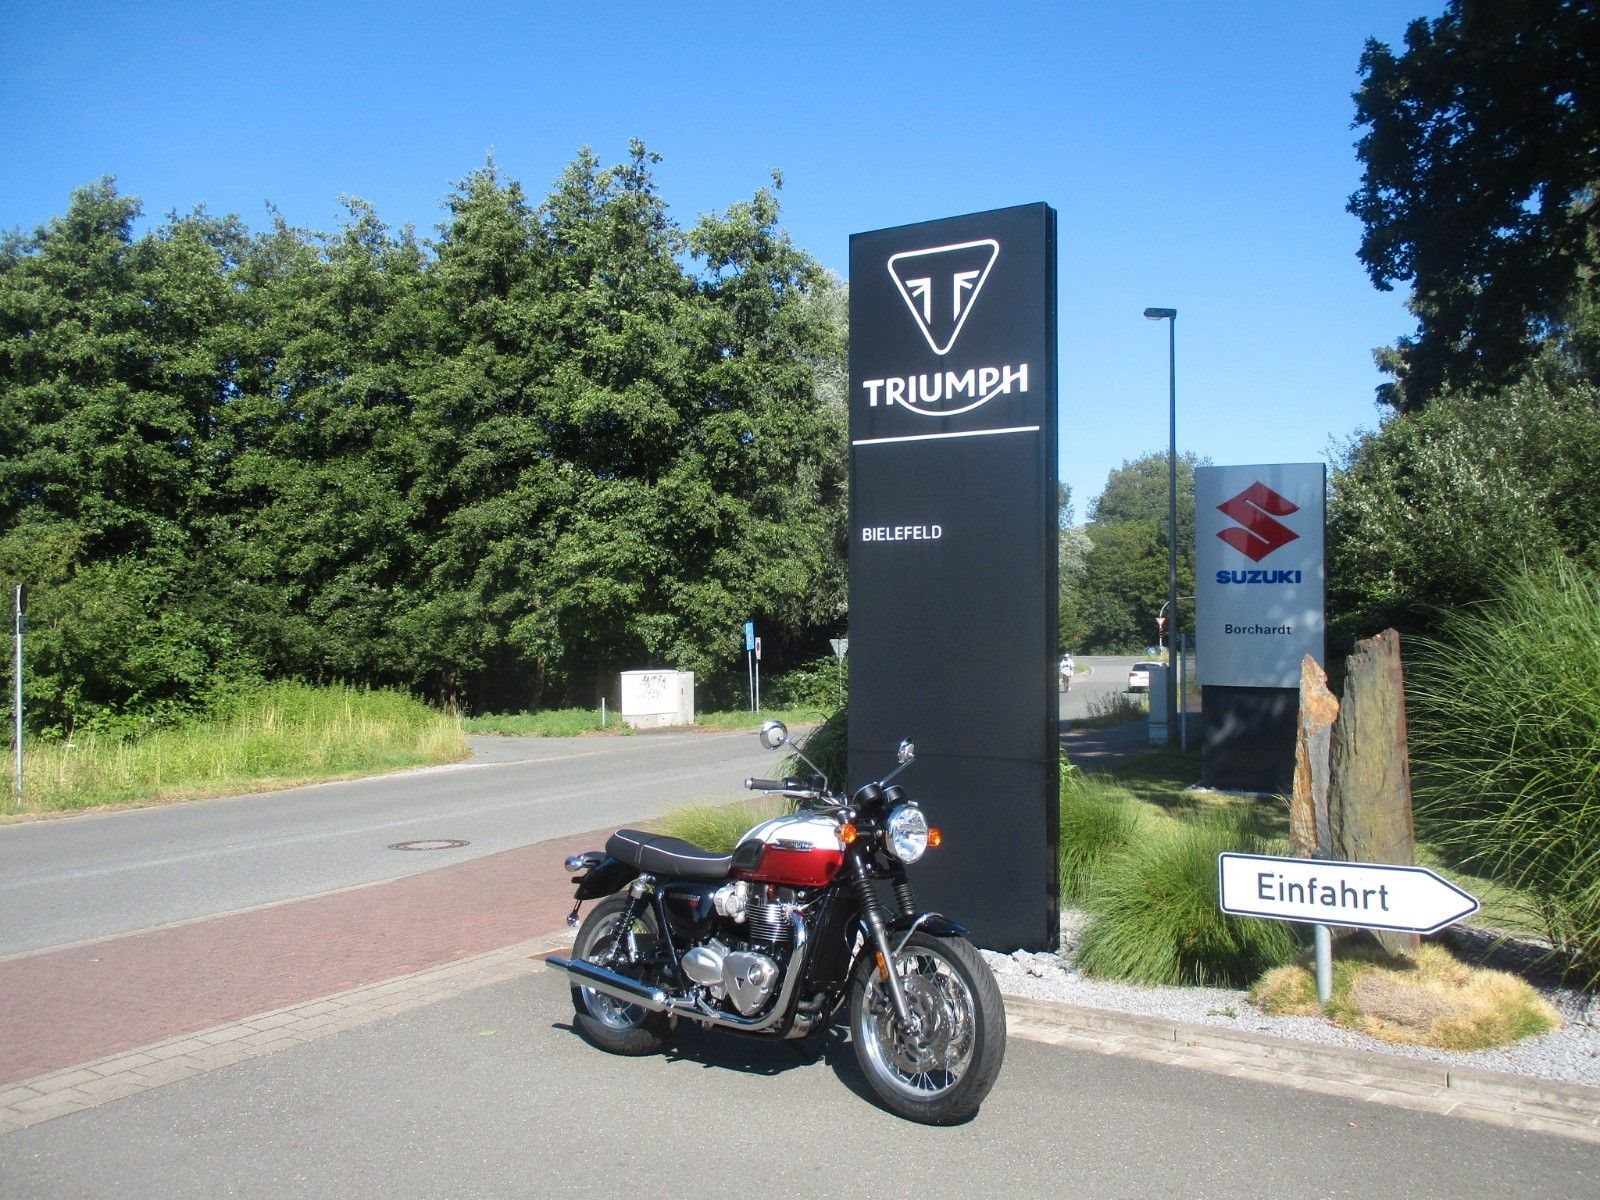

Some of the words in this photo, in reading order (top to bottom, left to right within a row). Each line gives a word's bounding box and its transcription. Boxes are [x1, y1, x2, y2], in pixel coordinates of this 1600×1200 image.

[862, 363, 1028, 416] TRIUMPH
[862, 525, 942, 541] BIELEFELD
[1216, 570, 1301, 584] SUZUKI
[1225, 624, 1292, 635] Borchardt
[1257, 872, 1389, 911] Einfahrt
